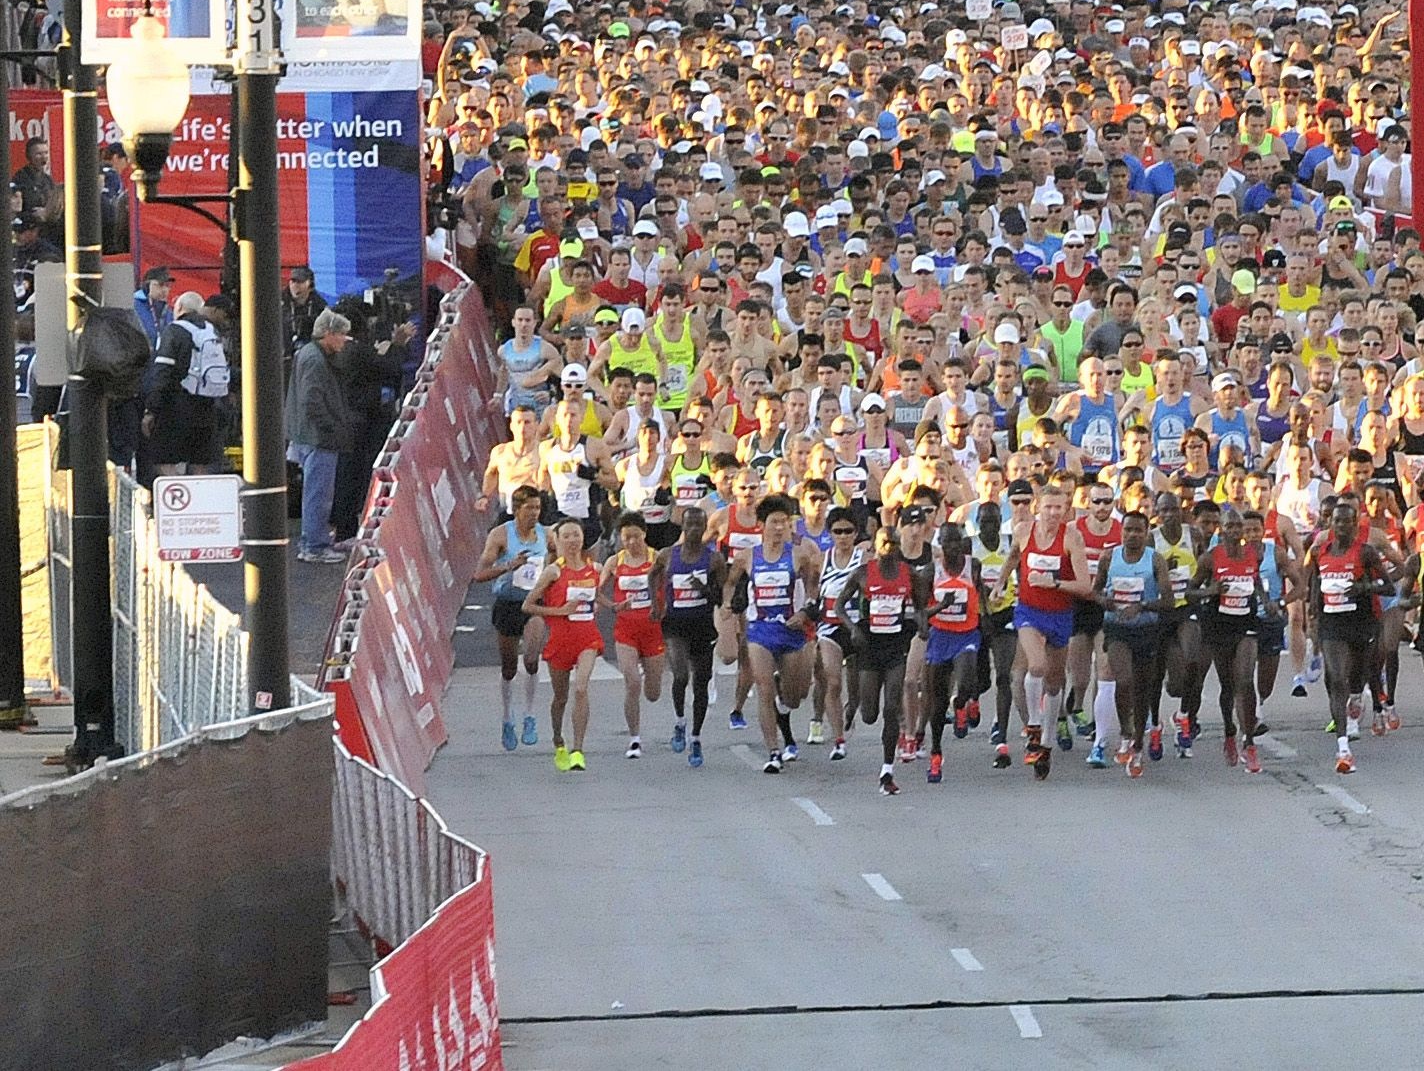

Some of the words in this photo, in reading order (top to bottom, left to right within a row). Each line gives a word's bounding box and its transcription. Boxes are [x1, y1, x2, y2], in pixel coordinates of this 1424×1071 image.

[333, 116, 402, 138] when
[163, 549, 191, 560] TOW
[198, 548, 234, 559] ZONE
